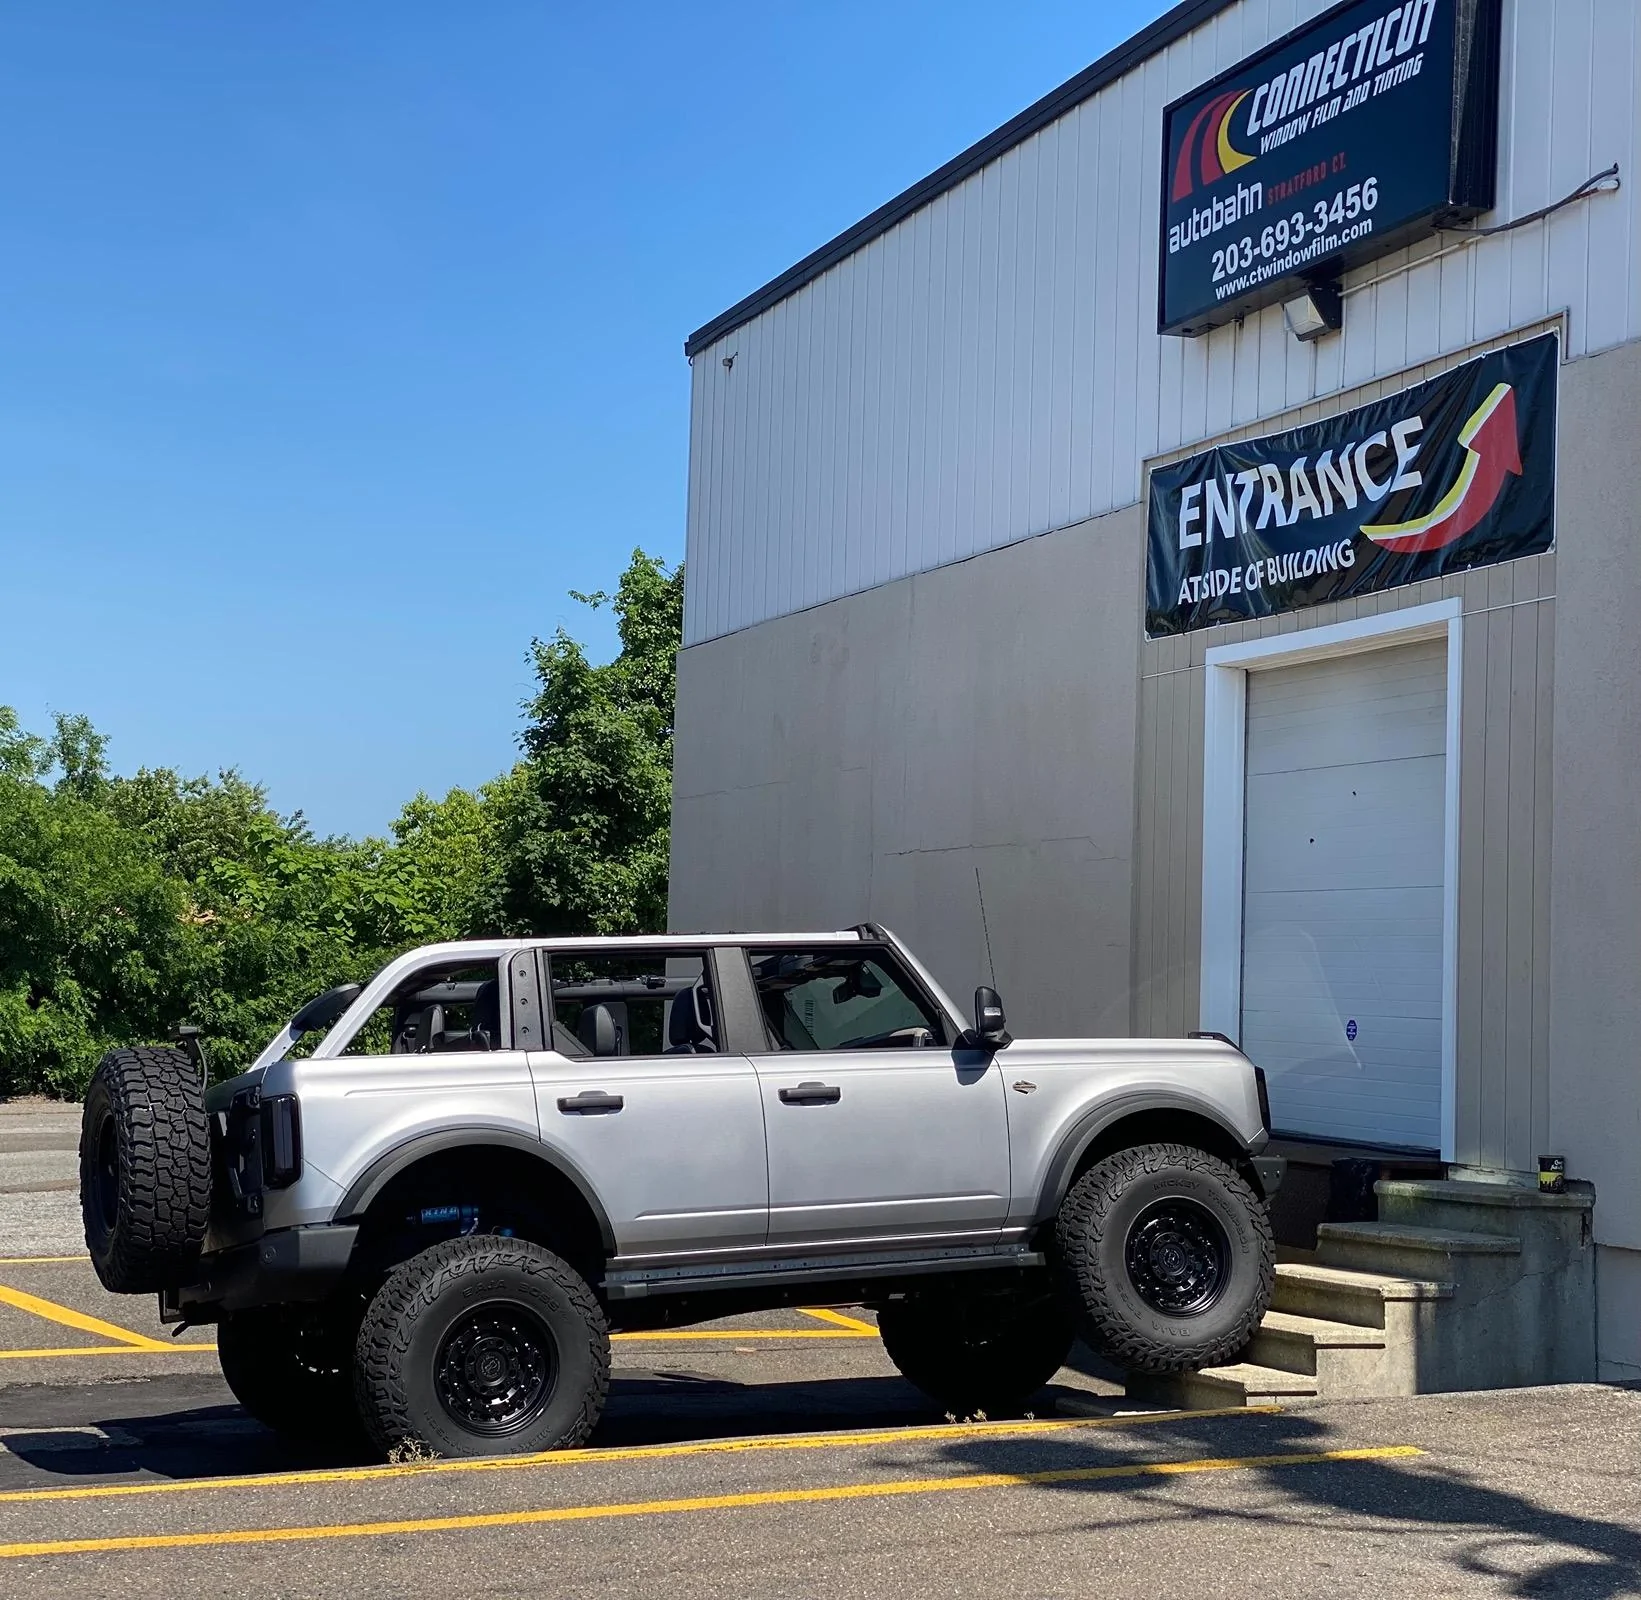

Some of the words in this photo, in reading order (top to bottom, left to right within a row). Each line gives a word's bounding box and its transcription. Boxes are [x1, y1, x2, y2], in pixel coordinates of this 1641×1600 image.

[1246, 0, 1437, 137] CONNECTICUT
[1260, 111, 1311, 155] WINDOW
[1311, 95, 1342, 129] FILM
[1372, 52, 1424, 97] TINTING
[1169, 182, 1263, 254] autobahn
[1268, 161, 1327, 206] STRATFORD
[1211, 176, 1378, 282] 203-693-3456
[1215, 218, 1373, 300] www.ctwindowfilm.com
[1178, 415, 1424, 549] ENTRANCE
[1244, 560, 1265, 591] OF
[1267, 538, 1356, 586] BUILDING
